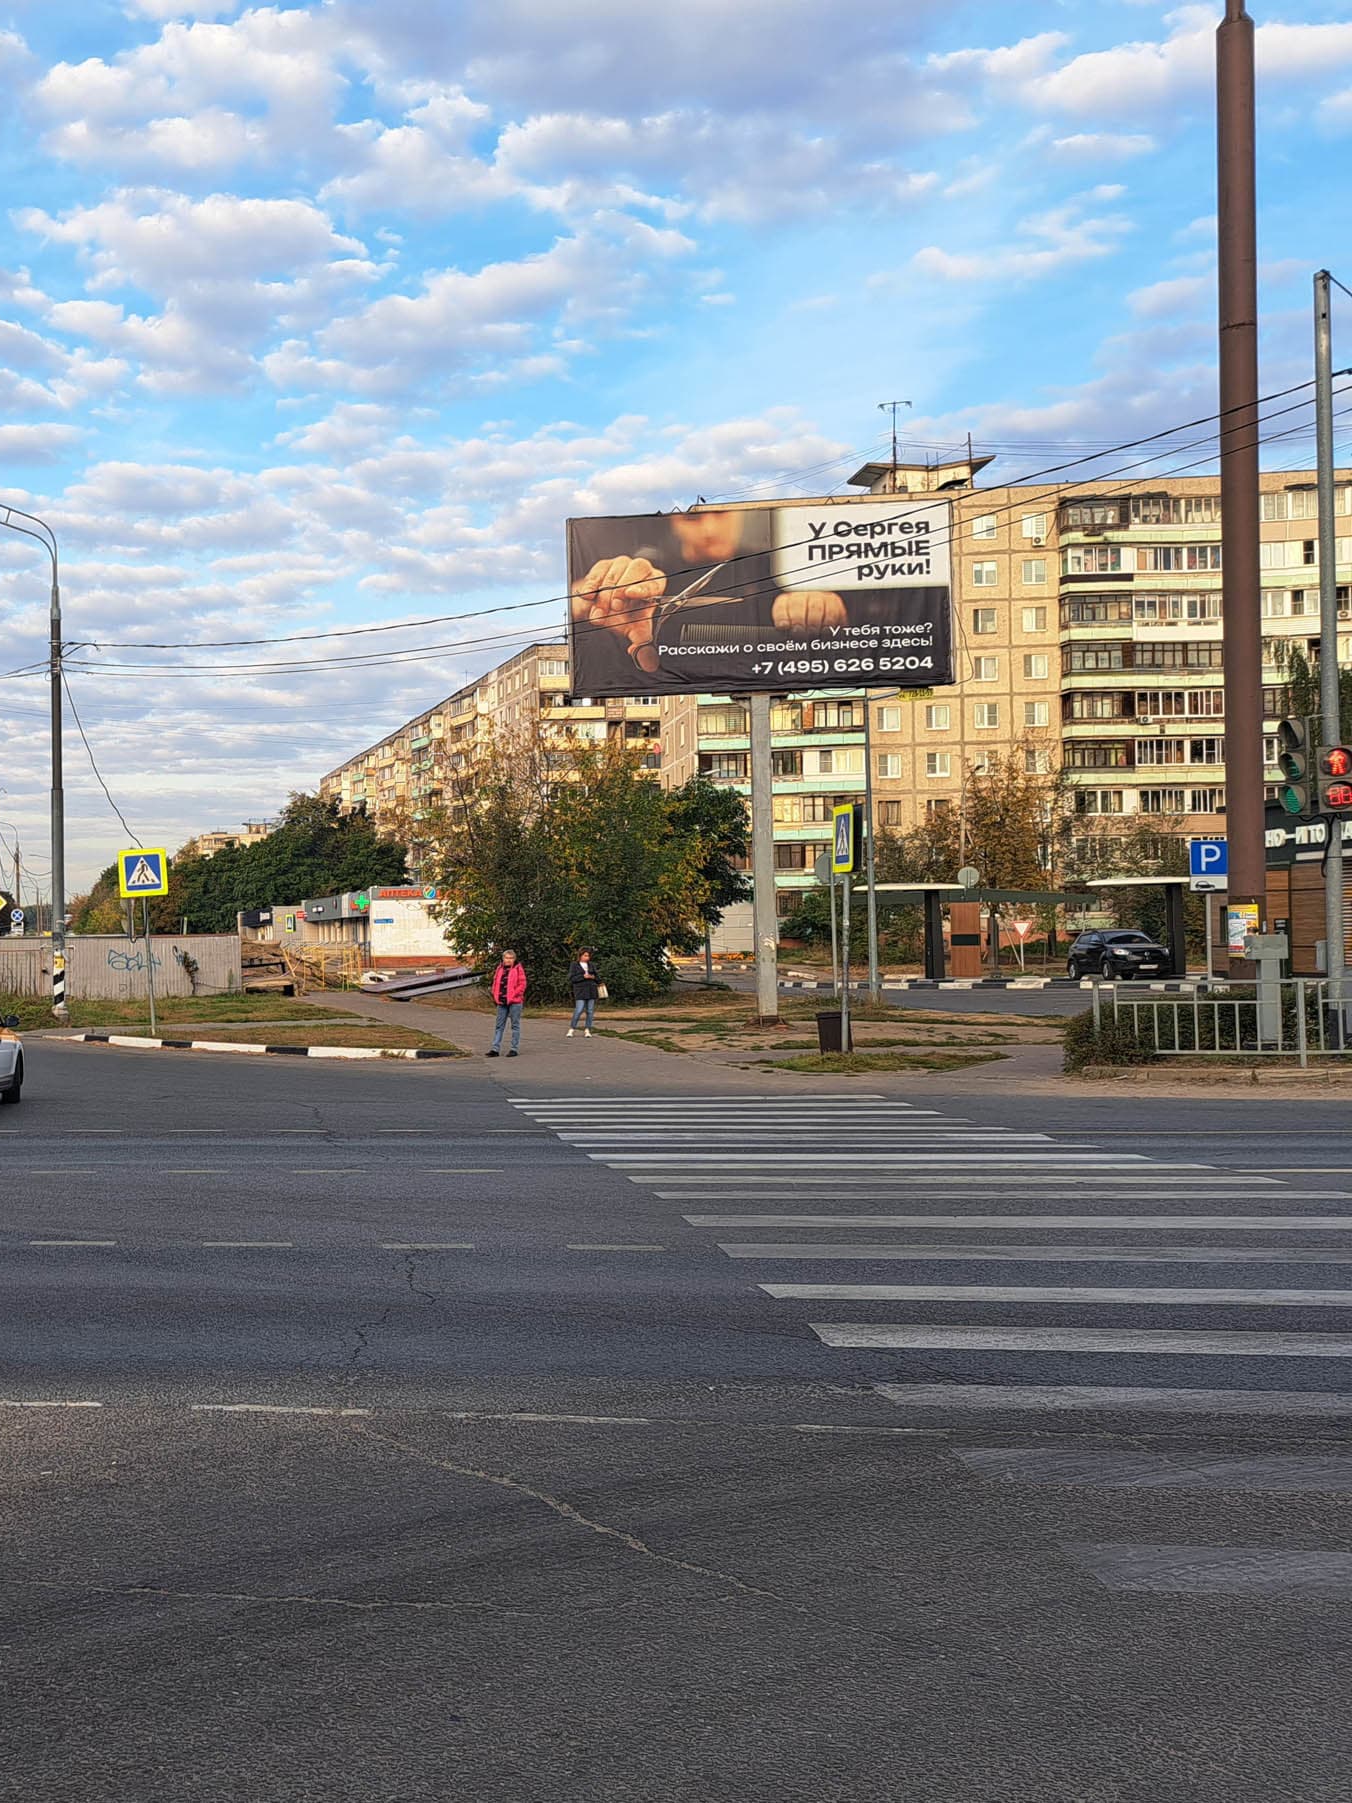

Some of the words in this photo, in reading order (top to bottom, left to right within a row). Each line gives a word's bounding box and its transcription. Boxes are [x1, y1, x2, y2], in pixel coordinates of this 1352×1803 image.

[808, 521, 827, 539] У
[833, 520, 930, 539] Сергея
[808, 540, 931, 561] ПРЯМЫЕ
[857, 558, 931, 581] руки!
[829, 626, 840, 637] У
[843, 624, 880, 636] тебя
[883, 622, 933, 634] тоже?
[658, 644, 739, 656] Расскажи
[743, 643, 753, 653] о
[757, 640, 807, 653] своём
[810, 639, 878, 651] бизнесе
[881, 635, 933, 648] здесь!
[751, 661, 774, 675] +7
[777, 659, 829, 676] (495)
[833, 658, 874, 672] 626
[879, 656, 934, 670] 5204
[379, 888, 422, 898] АПТЕКА
